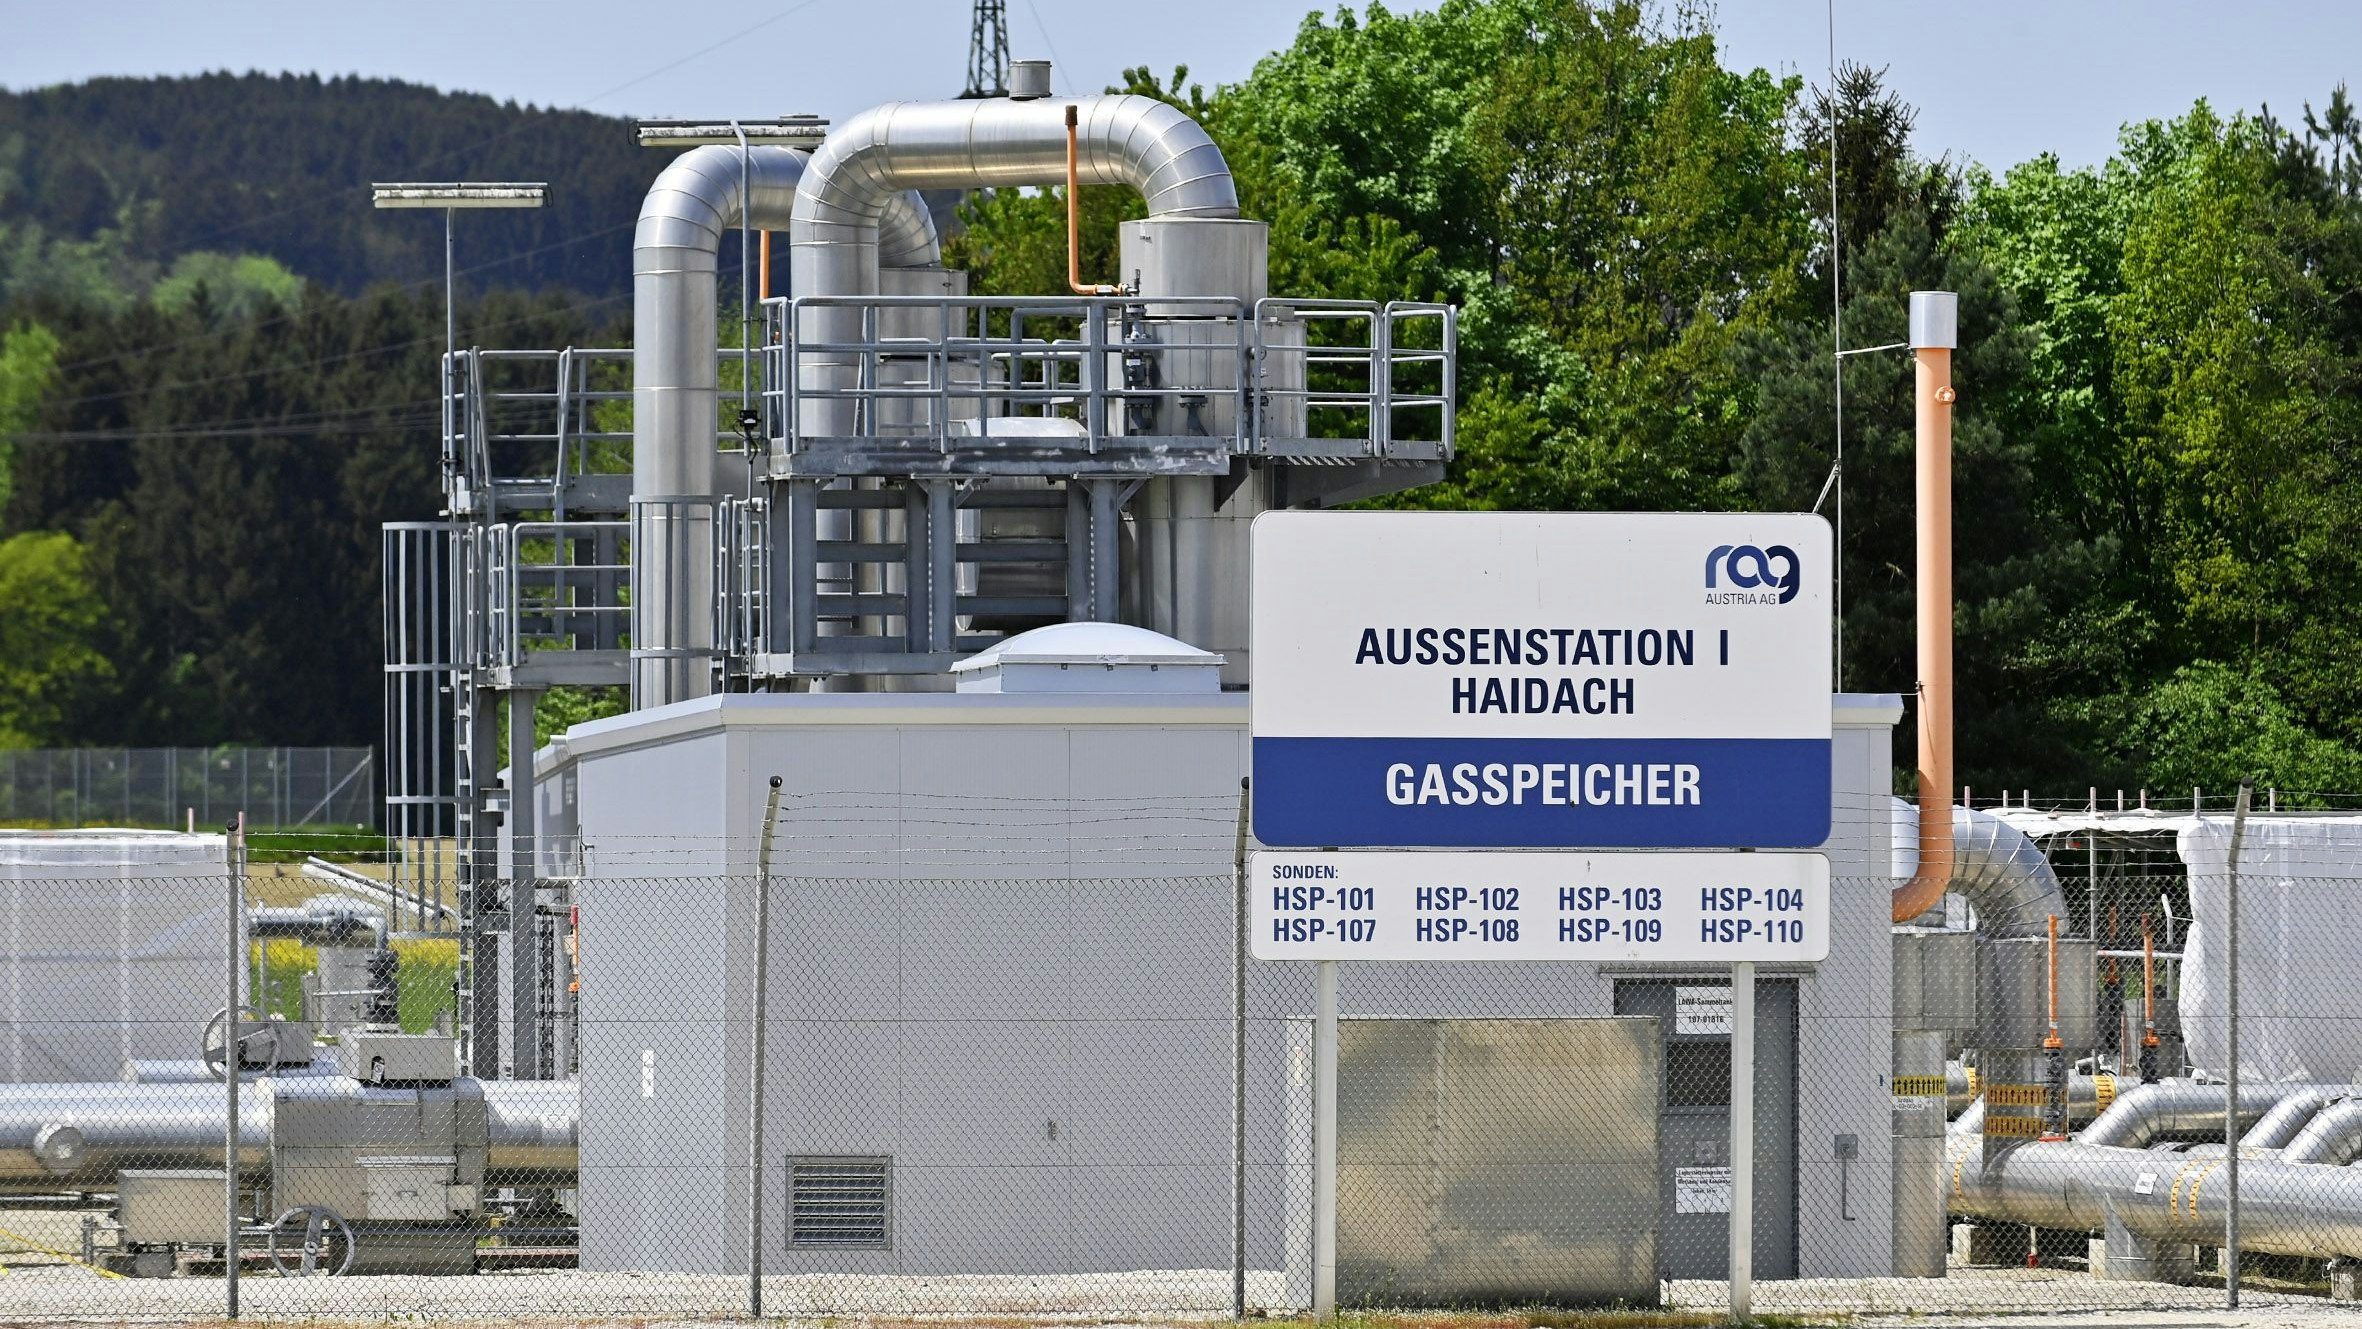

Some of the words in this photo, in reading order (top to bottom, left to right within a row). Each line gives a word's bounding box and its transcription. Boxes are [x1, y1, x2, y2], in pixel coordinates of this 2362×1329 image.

[1706, 593, 1757, 605] AUSTRIA
[1759, 593, 1777, 605] AG
[1355, 627, 1694, 666] AUSSENSTATION
[1719, 629, 1729, 666] I
[1452, 677, 1635, 715] HAIDACH
[1386, 762, 1701, 806] GASSPEICHER
[1272, 864, 1339, 880] SONDEN:
[1273, 887, 1376, 911] HSP-101
[1416, 887, 1520, 911] HSP-102
[1559, 887, 1662, 911] HSP-103
[1701, 887, 1804, 911] HSP-104
[1273, 918, 1376, 943] HSP-107
[1416, 918, 1520, 943] HSP-108
[1559, 918, 1662, 943] HSP-109
[1701, 918, 1804, 943] HSP-110
